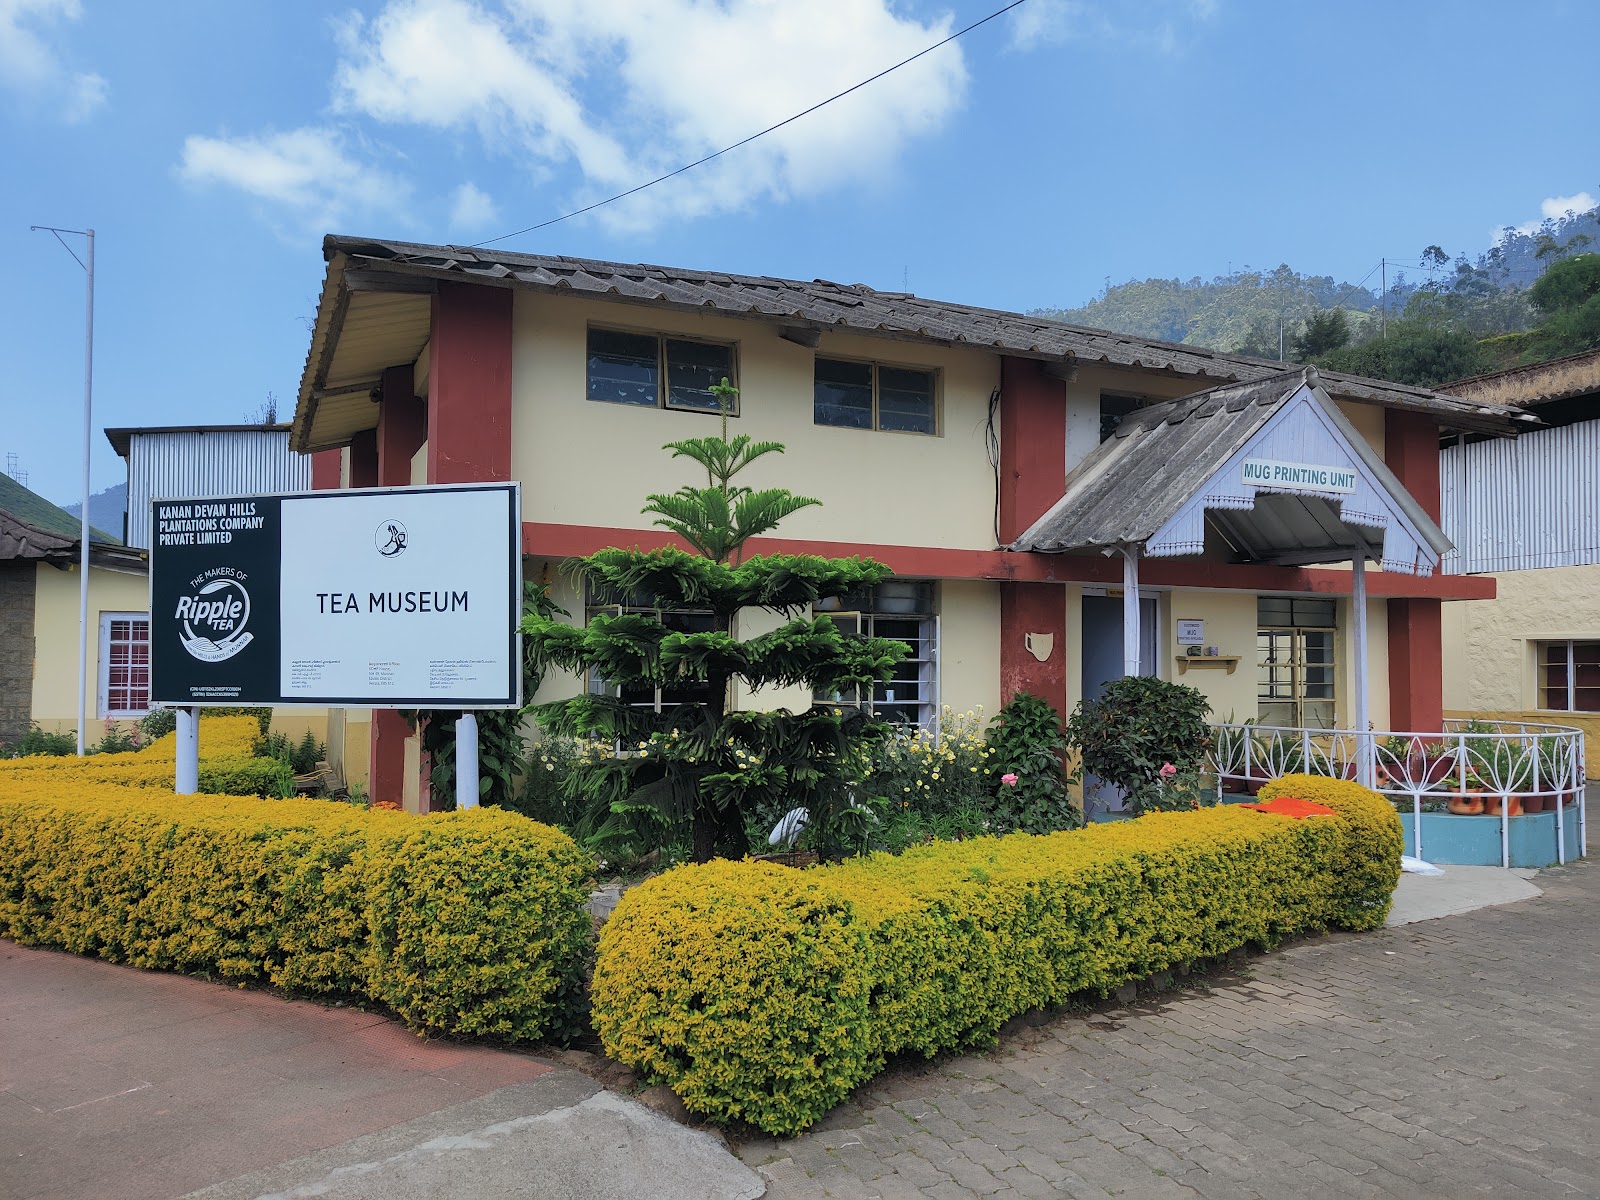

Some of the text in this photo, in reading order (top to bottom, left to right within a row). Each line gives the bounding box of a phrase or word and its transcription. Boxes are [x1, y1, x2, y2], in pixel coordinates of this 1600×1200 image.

[1244, 463, 1355, 488] MUG PRINTING UNIT
[159, 502, 256, 520] KANAN DEVAN HILLS
[159, 516, 265, 533] PLANTATIONS COMPANY
[159, 531, 232, 546] PRIVATE LIMITED
[189, 566, 248, 588] THE MAKERS OF
[174, 594, 243, 626] Ripple
[316, 590, 469, 614] TEA MUSEUM
[212, 619, 234, 631] TEA
[229, 635, 249, 653] MUNNAR
